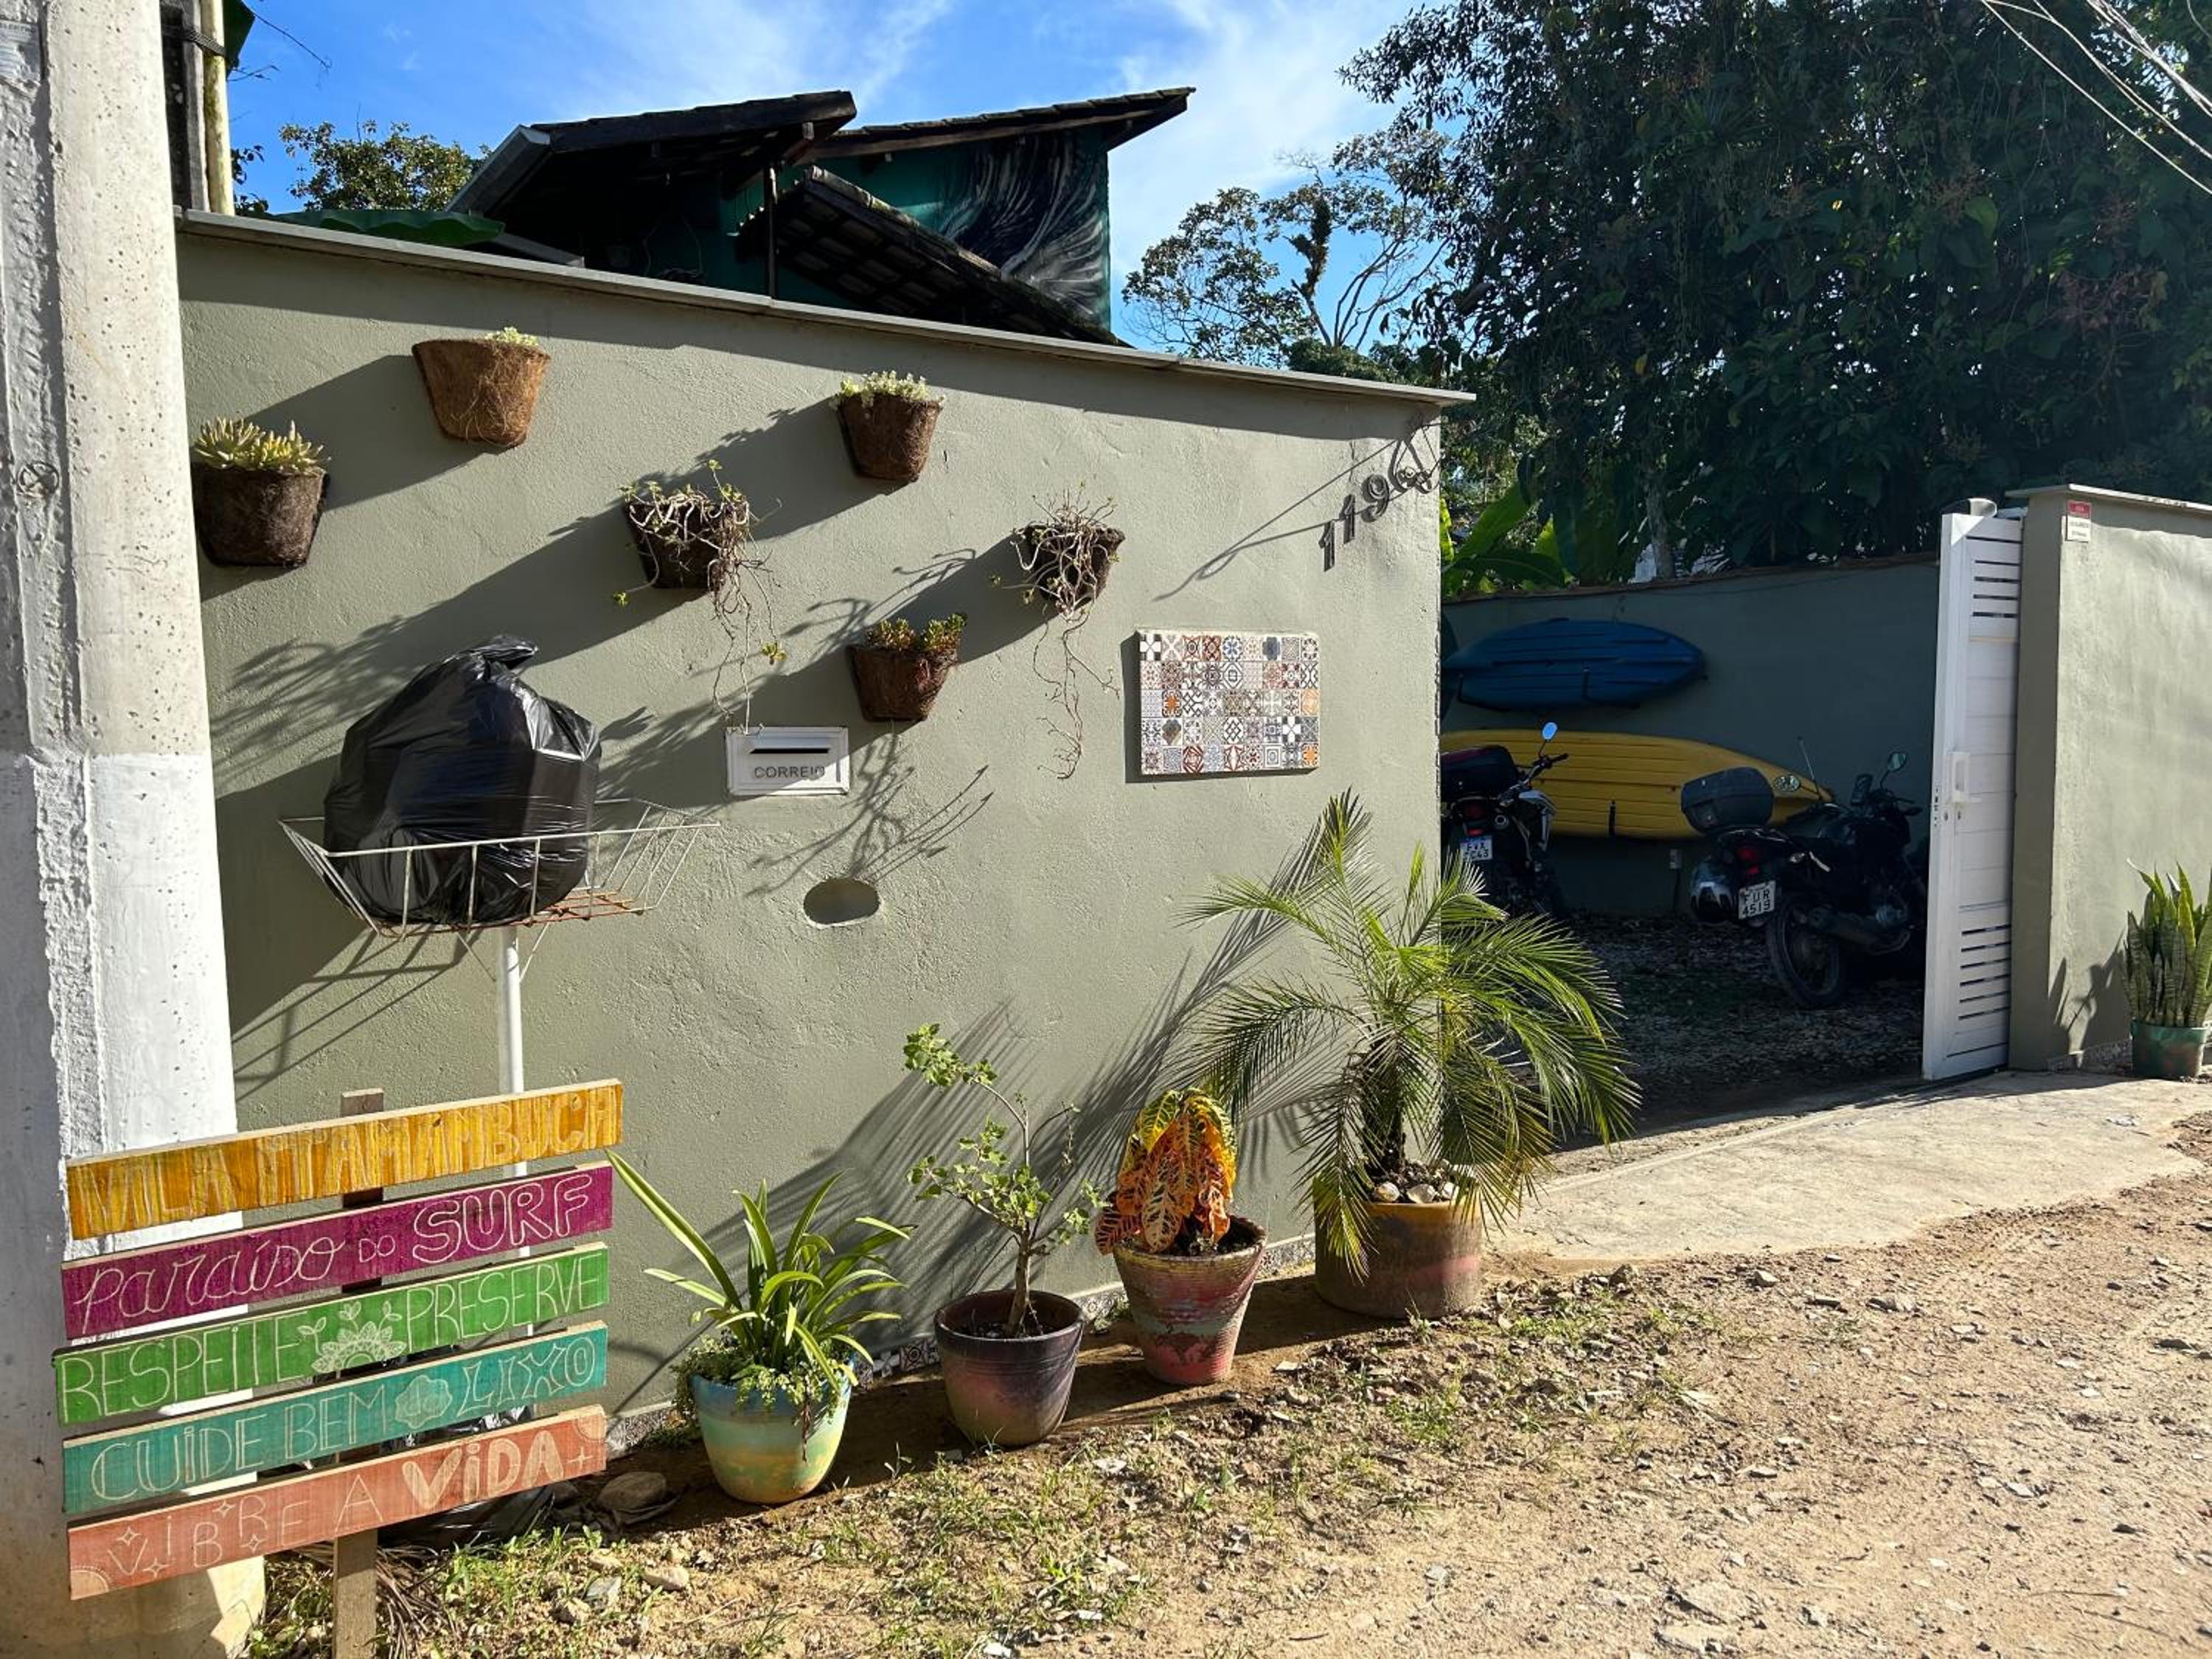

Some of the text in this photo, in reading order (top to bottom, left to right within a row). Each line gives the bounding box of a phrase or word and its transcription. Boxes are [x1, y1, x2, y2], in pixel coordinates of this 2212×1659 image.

[754, 766, 825, 779] CORREIO
[74, 1145, 237, 1239] VILA
[411, 1174, 593, 1264] SURF
[406, 1252, 608, 1352] PRESERVE
[284, 1384, 388, 1460] BEM
[457, 1336, 595, 1416] LIXO
[335, 1474, 385, 1535] A
